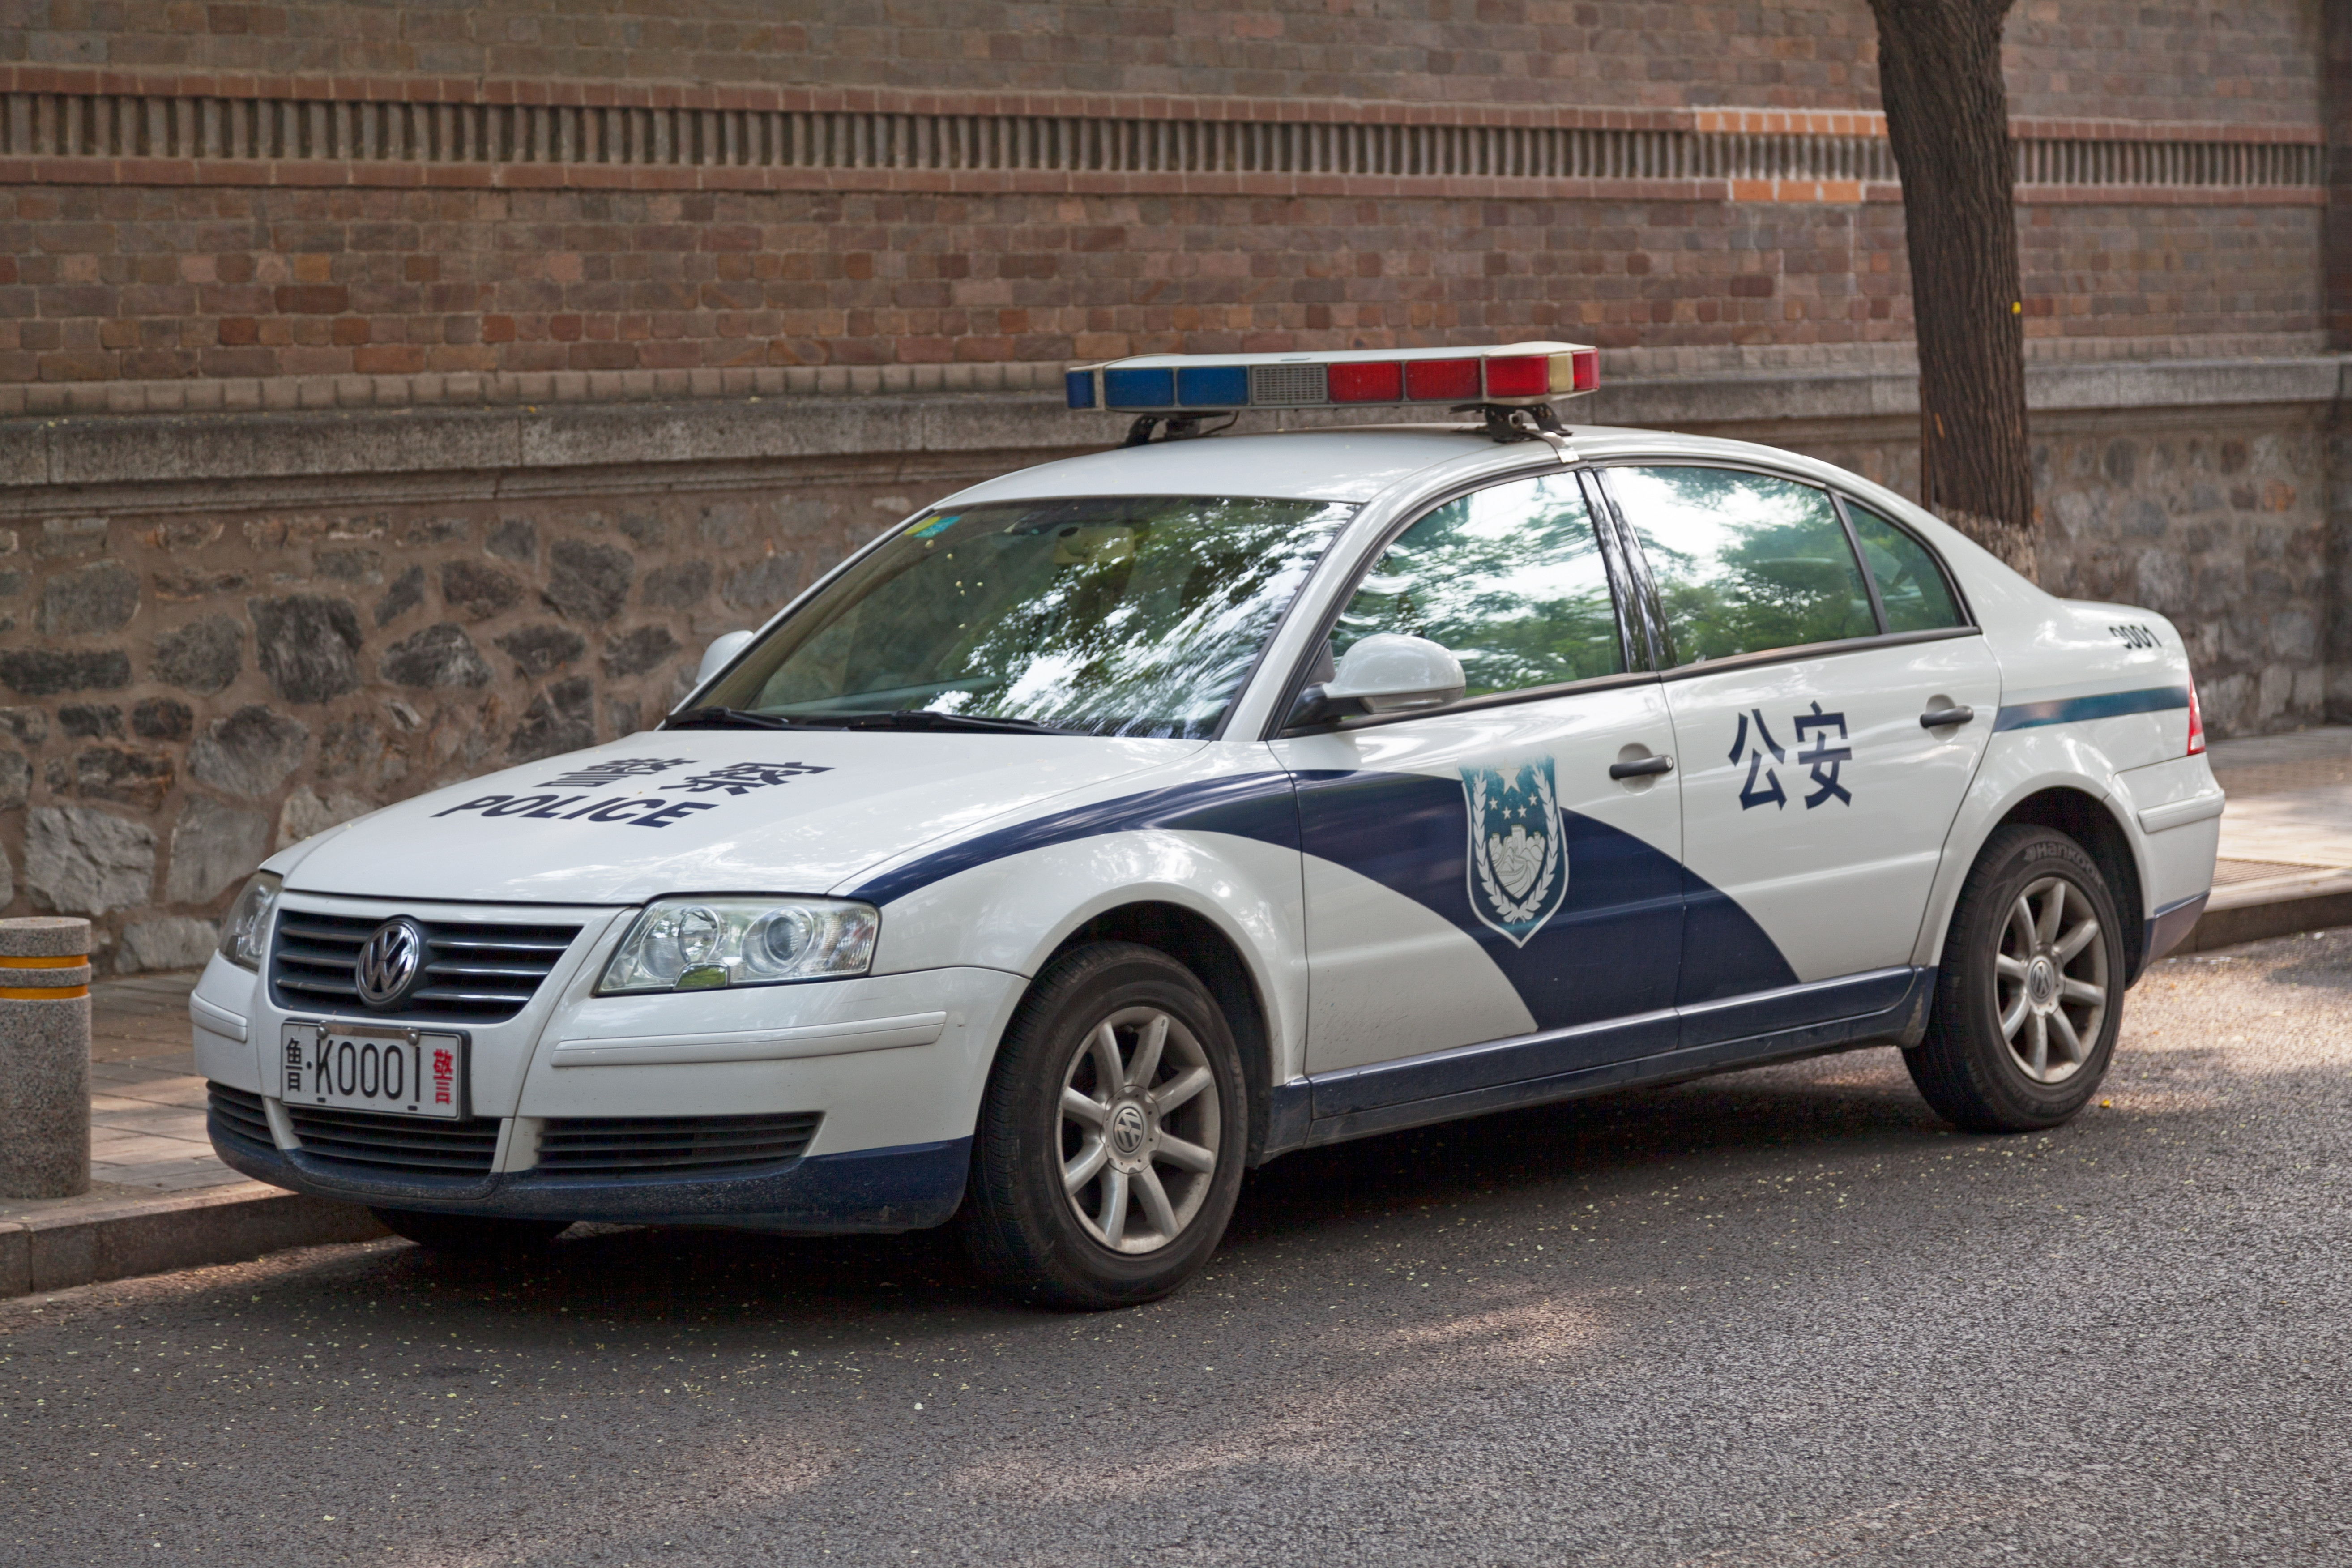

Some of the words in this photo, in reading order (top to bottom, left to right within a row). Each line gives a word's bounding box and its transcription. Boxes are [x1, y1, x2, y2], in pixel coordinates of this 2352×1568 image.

[1728, 700, 1852, 811] 公安
[532, 758, 835, 795] 警察
[430, 794, 720, 828] POLICE
